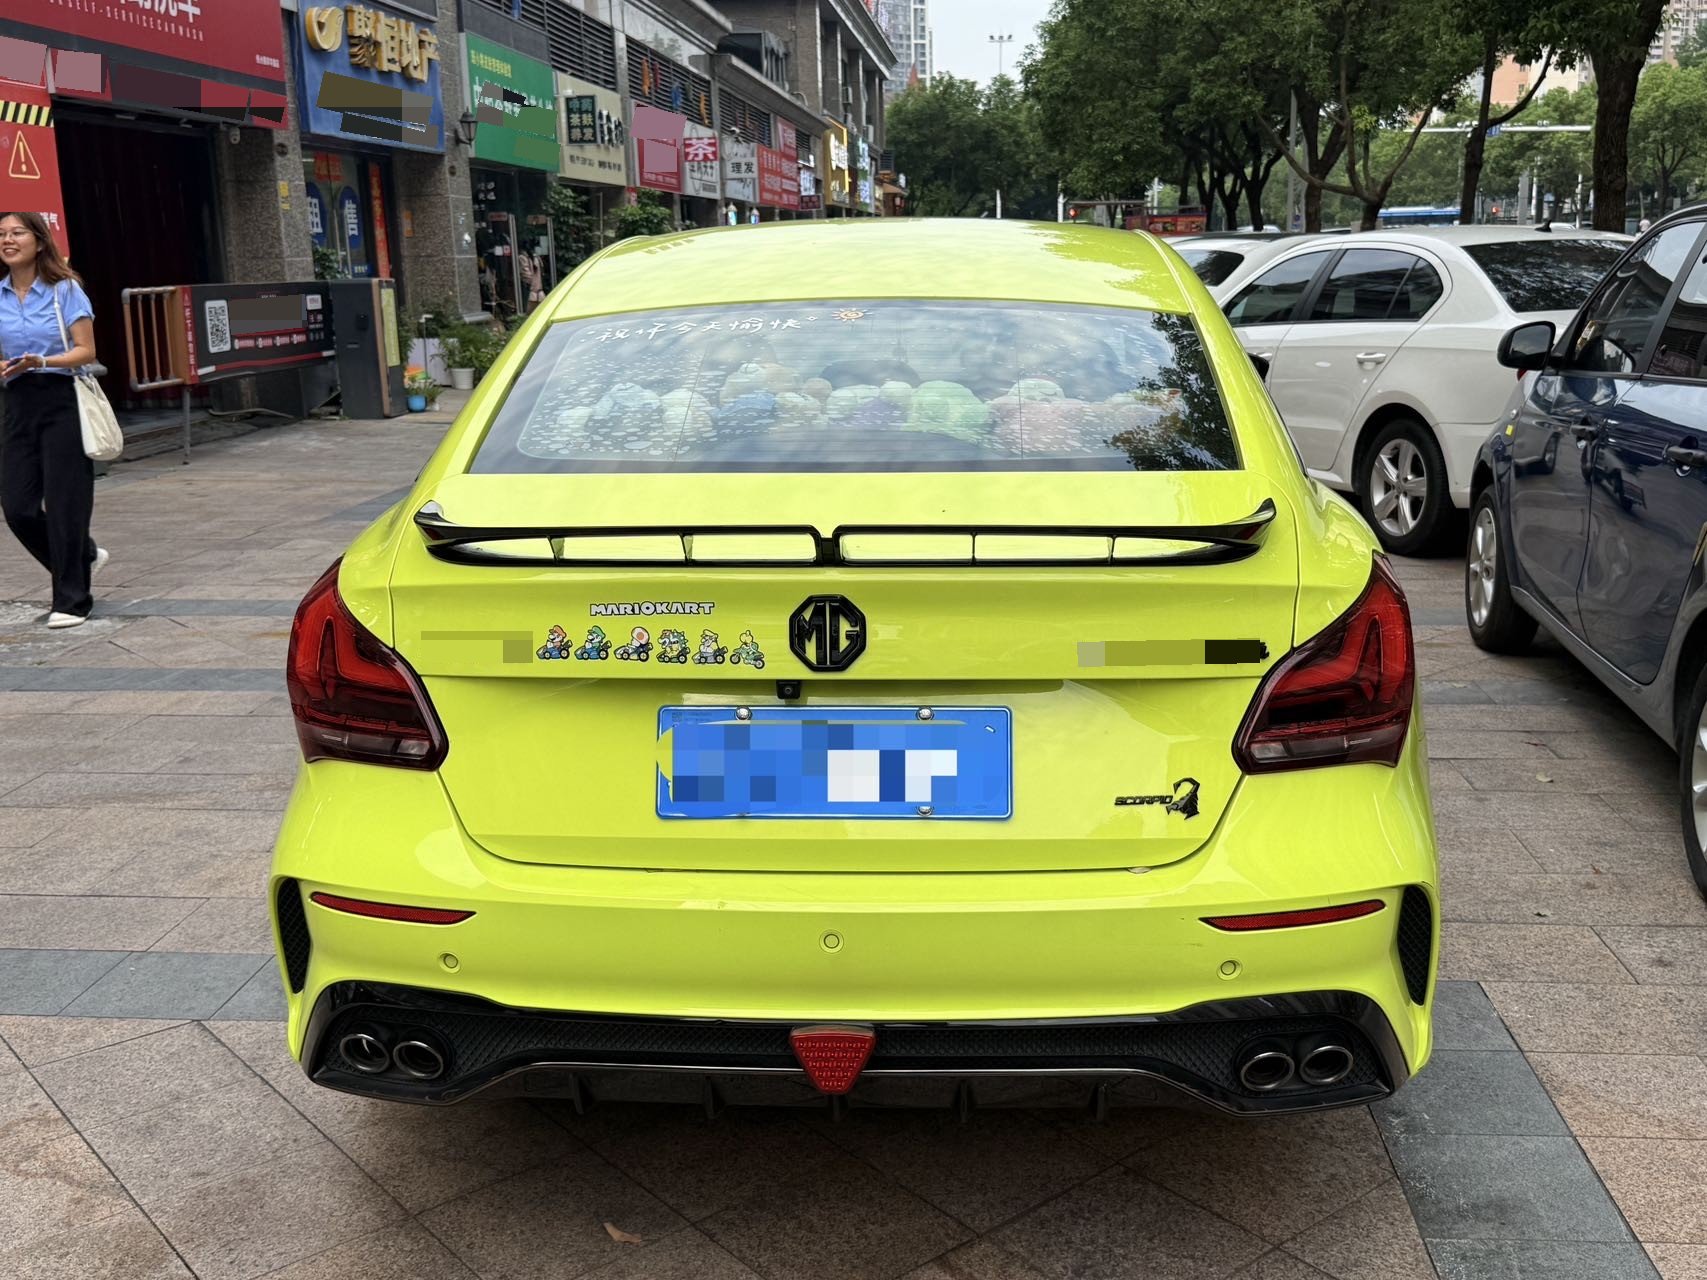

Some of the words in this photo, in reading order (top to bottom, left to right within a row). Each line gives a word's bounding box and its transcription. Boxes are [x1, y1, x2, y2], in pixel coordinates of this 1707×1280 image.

[346, 4, 440, 83] 聚恒地产
[685, 138, 717, 161] 茶
[731, 161, 755, 175] 理发
[793, 600, 862, 666] MG
[1115, 795, 1174, 806] SCORPIO
